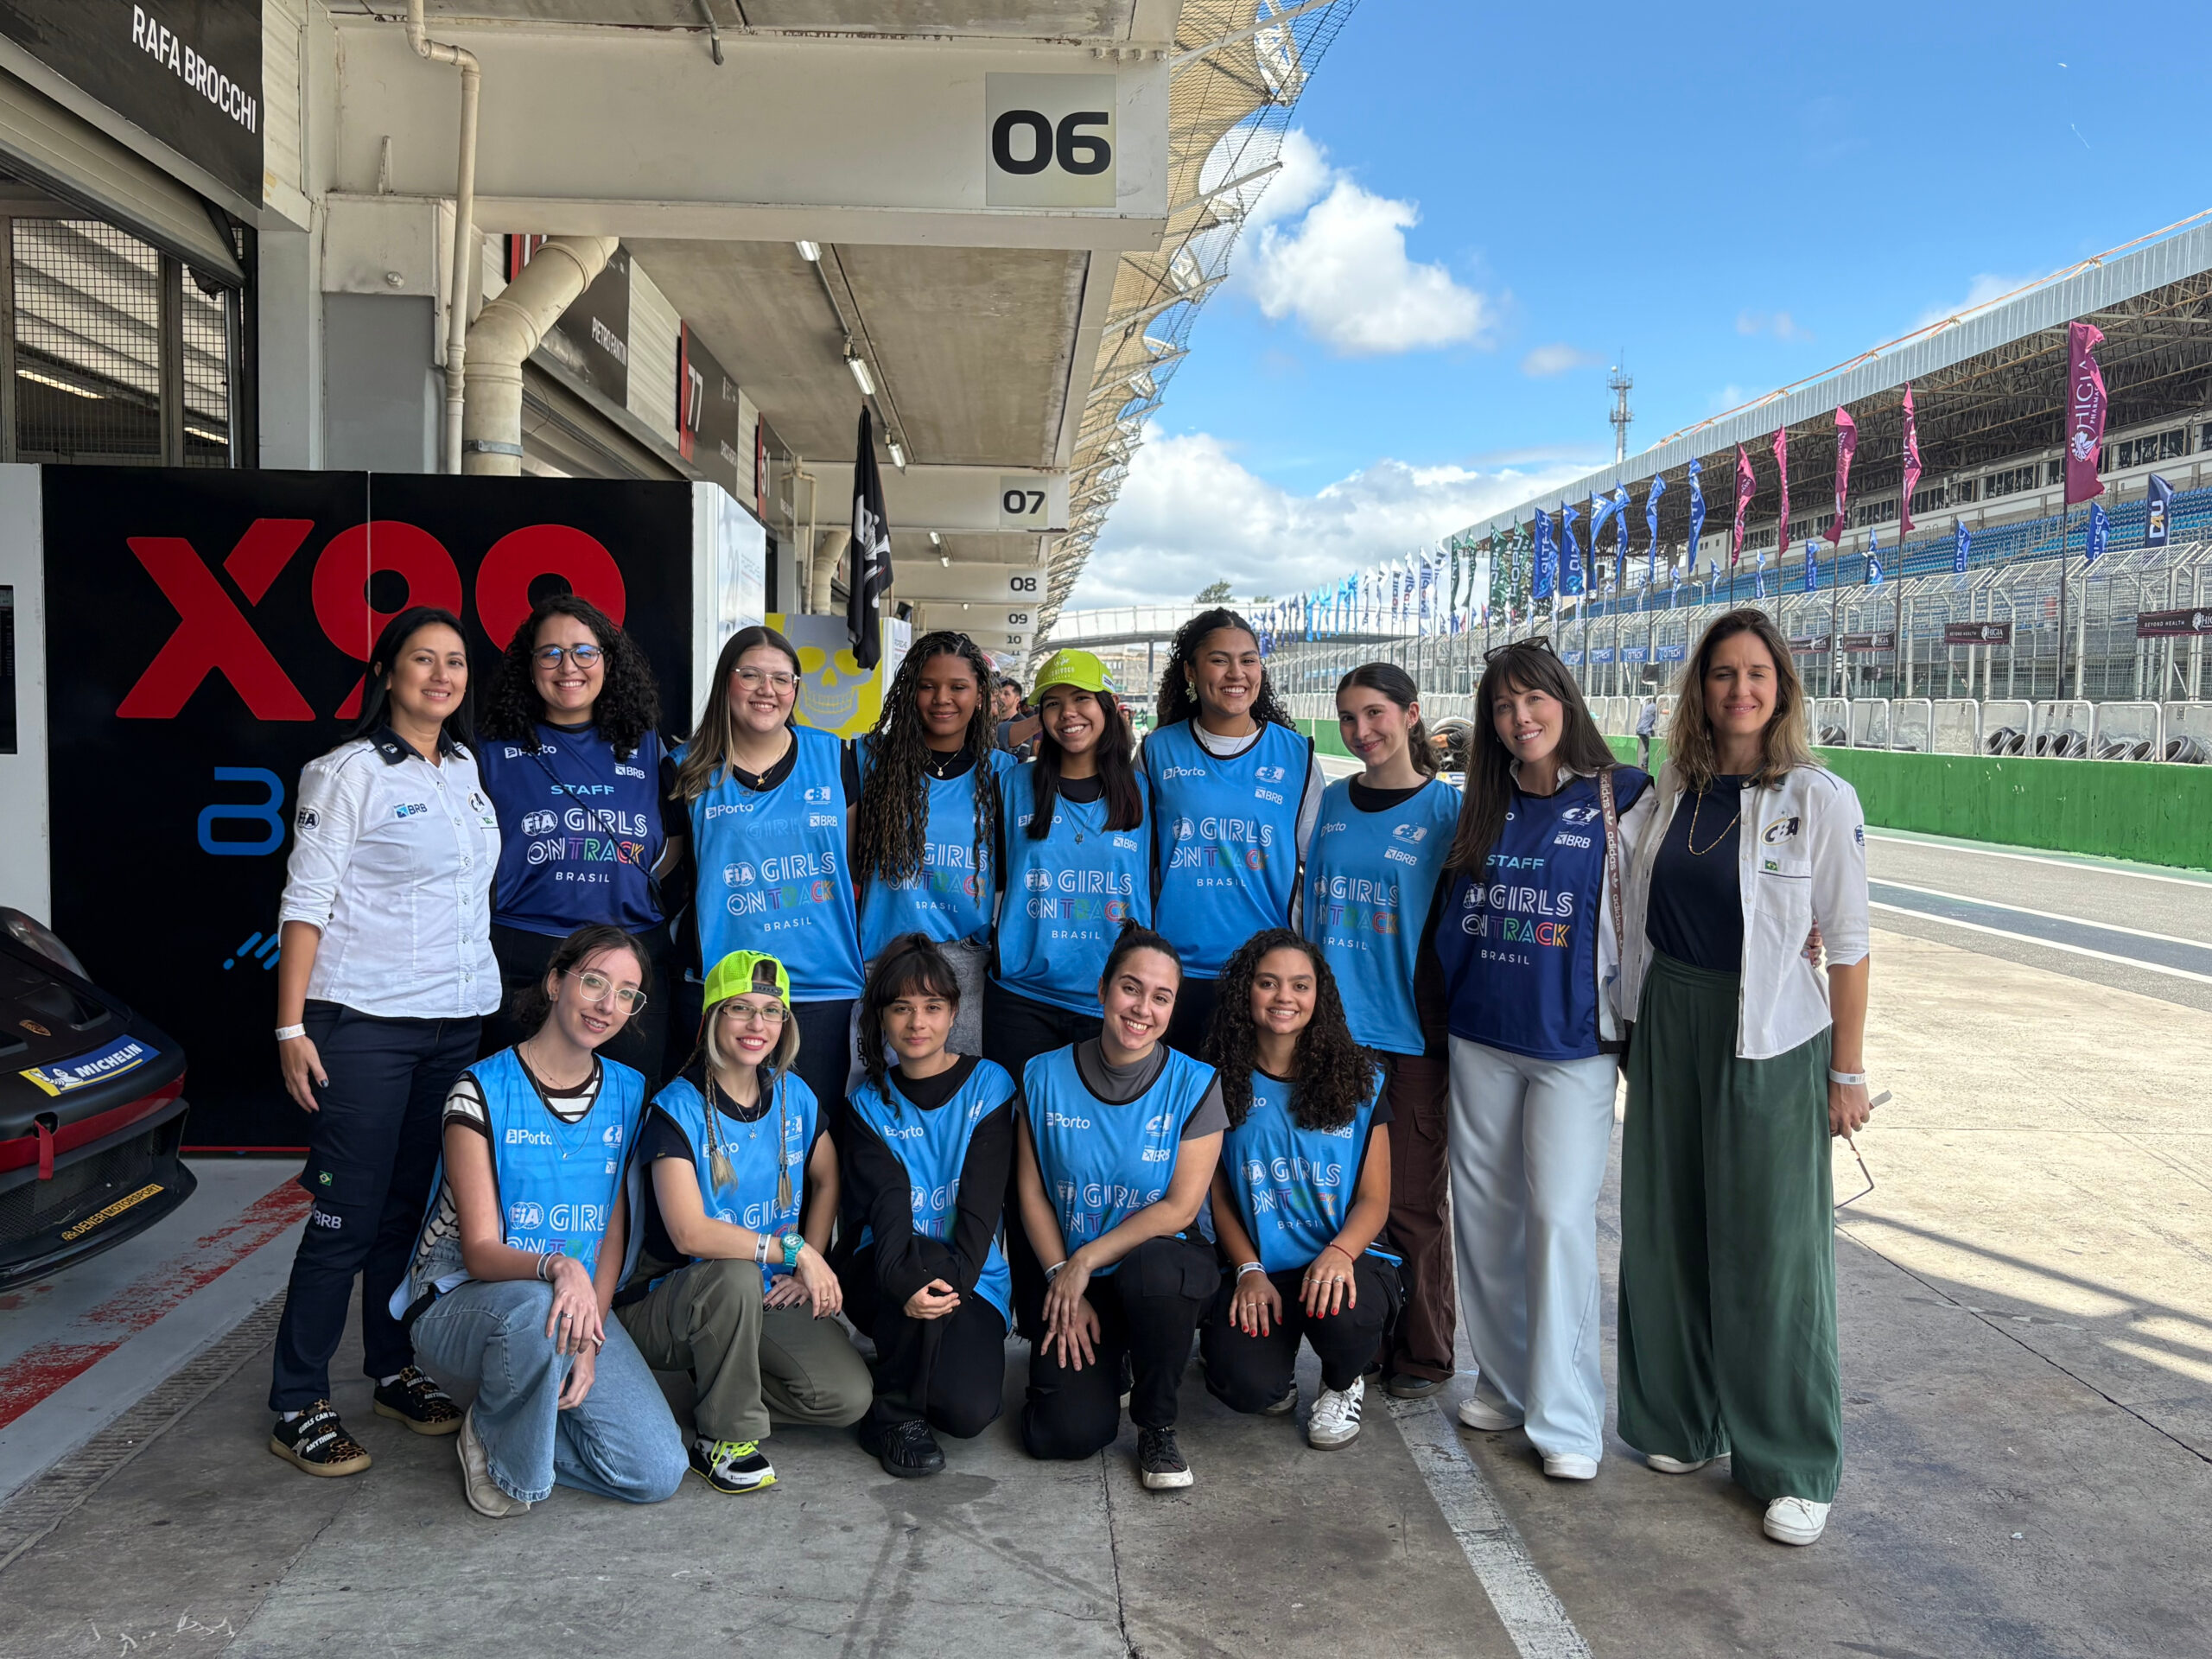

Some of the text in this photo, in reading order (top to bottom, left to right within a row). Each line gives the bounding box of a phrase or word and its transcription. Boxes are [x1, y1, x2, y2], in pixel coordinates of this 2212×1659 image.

[132, 3, 256, 134] RAFA BROCCHI
[991, 110, 1111, 175] 06
[689, 363, 702, 432] 77
[761, 445, 771, 498] 51
[1003, 490, 1046, 514] 07
[1010, 577, 1037, 591] 08
[1008, 613, 1027, 624] 09
[1007, 635, 1021, 644] 10
[626, 766, 645, 779] BRB
[1173, 766, 1206, 778] Porto
[550, 784, 614, 795] STAFF
[1265, 791, 1284, 805] BRB
[1600, 773, 1611, 809] adidas
[408, 802, 428, 816] BRB
[717, 803, 754, 817] Porto
[564, 808, 647, 837] GIRLS
[821, 815, 837, 827] BRB
[1324, 822, 1346, 835] Porto
[1199, 817, 1274, 847] GIRLS
[1566, 836, 1591, 849] BRB
[527, 837, 645, 865] ON TRACK
[1124, 837, 1137, 852] BRB
[1607, 831, 1618, 871] adidas
[761, 851, 836, 882] GIRLS
[923, 842, 988, 872] GIRLS
[1395, 851, 1417, 866] BRB
[1486, 854, 1545, 870] STAFF
[556, 872, 610, 882] BRASIL
[1058, 869, 1133, 896] GIRLS
[1197, 878, 1246, 887] BRASIL
[1330, 875, 1399, 907] GIRLS
[1489, 884, 1574, 918] GIRLS
[727, 890, 766, 916] ON
[916, 901, 958, 912] BRASIL
[1027, 898, 1058, 919] ON
[1612, 893, 1622, 933] adidas
[764, 917, 812, 932] BRASIL
[1052, 930, 1101, 939] BRASIL
[1491, 916, 1572, 948] TRACK
[1481, 950, 1530, 965] BRASIL
[74, 1042, 143, 1078] MICHELIN
[1055, 1113, 1090, 1129] Porto
[518, 1129, 553, 1146] Porto
[1154, 1148, 1171, 1162] BRB
[1270, 1156, 1342, 1187] GIRLS
[1084, 1183, 1162, 1209] GIRLS
[73, 1184, 162, 1235] DENER MOTORSPORT
[314, 1209, 342, 1229] BRB
[549, 1204, 609, 1232] GIRL
[298, 1418, 315, 1434] GIRLS
[315, 1413, 329, 1423] CAN
[306, 1431, 338, 1452] ANYTHING
